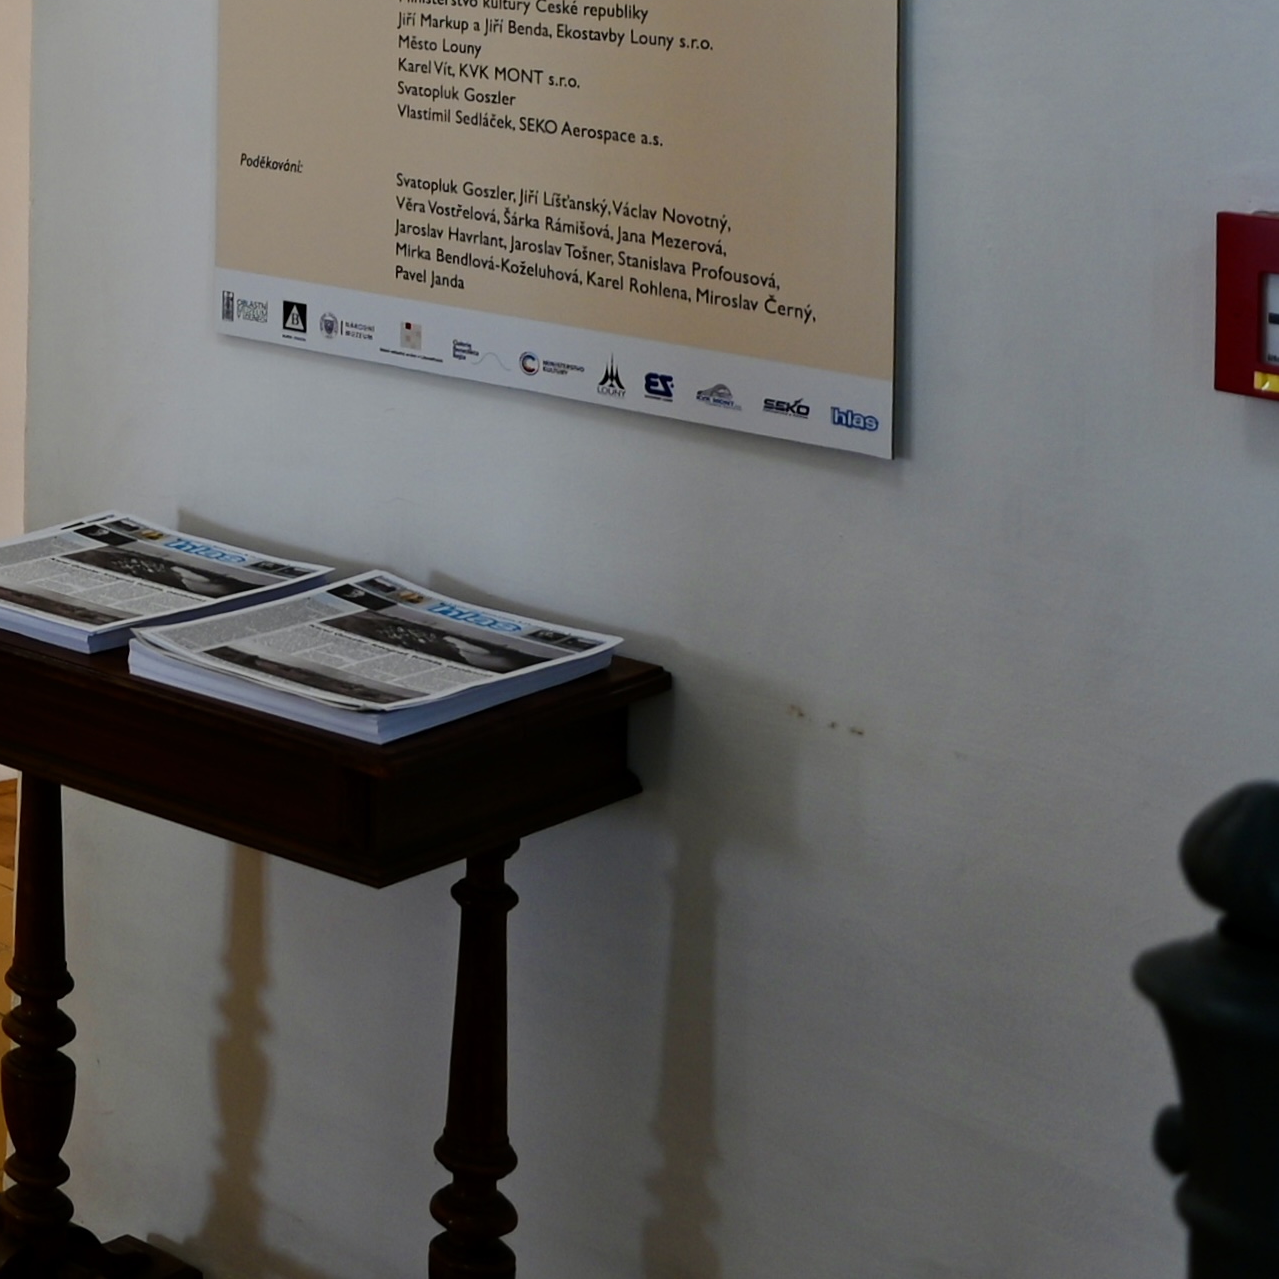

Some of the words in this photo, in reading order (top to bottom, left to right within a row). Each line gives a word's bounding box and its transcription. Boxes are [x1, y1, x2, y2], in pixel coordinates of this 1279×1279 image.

[584, 3, 648, 24] republiky
[397, 11, 416, 29] Jiří
[421, 13, 469, 34] Markup
[473, 22, 480, 31] a
[484, 18, 503, 36] Jiří
[508, 20, 552, 39] Benda,
[557, 23, 625, 47] Ekostavby
[631, 29, 674, 51] Louny
[679, 37, 713, 50] s.r.o.
[399, 34, 437, 51] Město
[443, 38, 481, 59] Louny
[398, 57, 431, 74] Karel
[434, 61, 455, 78] Vít,
[459, 63, 489, 80] KVK
[495, 66, 544, 85] MONT
[548, 76, 580, 89] s.r.o.
[397, 81, 459, 102] Svatopluk
[464, 87, 516, 106] Goszler
[397, 103, 450, 122] Vlastimil
[455, 110, 515, 131] Sedláček,
[519, 117, 558, 134] SEKO
[561, 121, 635, 145] Aerospace
[641, 134, 663, 146] a.s.
[240, 153, 303, 173] Poděkování:
[396, 172, 458, 195] Svatopluk
[463, 181, 516, 203] Goszler,
[518, 188, 539, 207] Jiří
[612, 200, 657, 220] Václav
[663, 207, 731, 234] Novotný,
[396, 196, 425, 213] Věra
[428, 200, 500, 225] Vostřelová,
[504, 207, 539, 229] Šárka
[545, 216, 614, 241] Rámišová,
[616, 226, 646, 245] Jana
[652, 230, 726, 257] Mezerová,
[395, 219, 443, 239] Jaroslav
[448, 226, 507, 250] Havrlant,
[509, 235, 562, 256] Jaroslav
[564, 243, 614, 266] Tošner,
[618, 251, 686, 275] Stanislava
[692, 261, 780, 291] Profousová,
[396, 265, 426, 283] Pavel
[430, 270, 464, 289] Janda
[396, 242, 431, 261] Mirka
[587, 270, 623, 290] Karel
[630, 277, 691, 303] Rohlena,
[696, 287, 758, 311] Miroslav
[764, 294, 816, 324] Černý,
[597, 386, 626, 398] LOUNY
[831, 406, 879, 431] hlas
